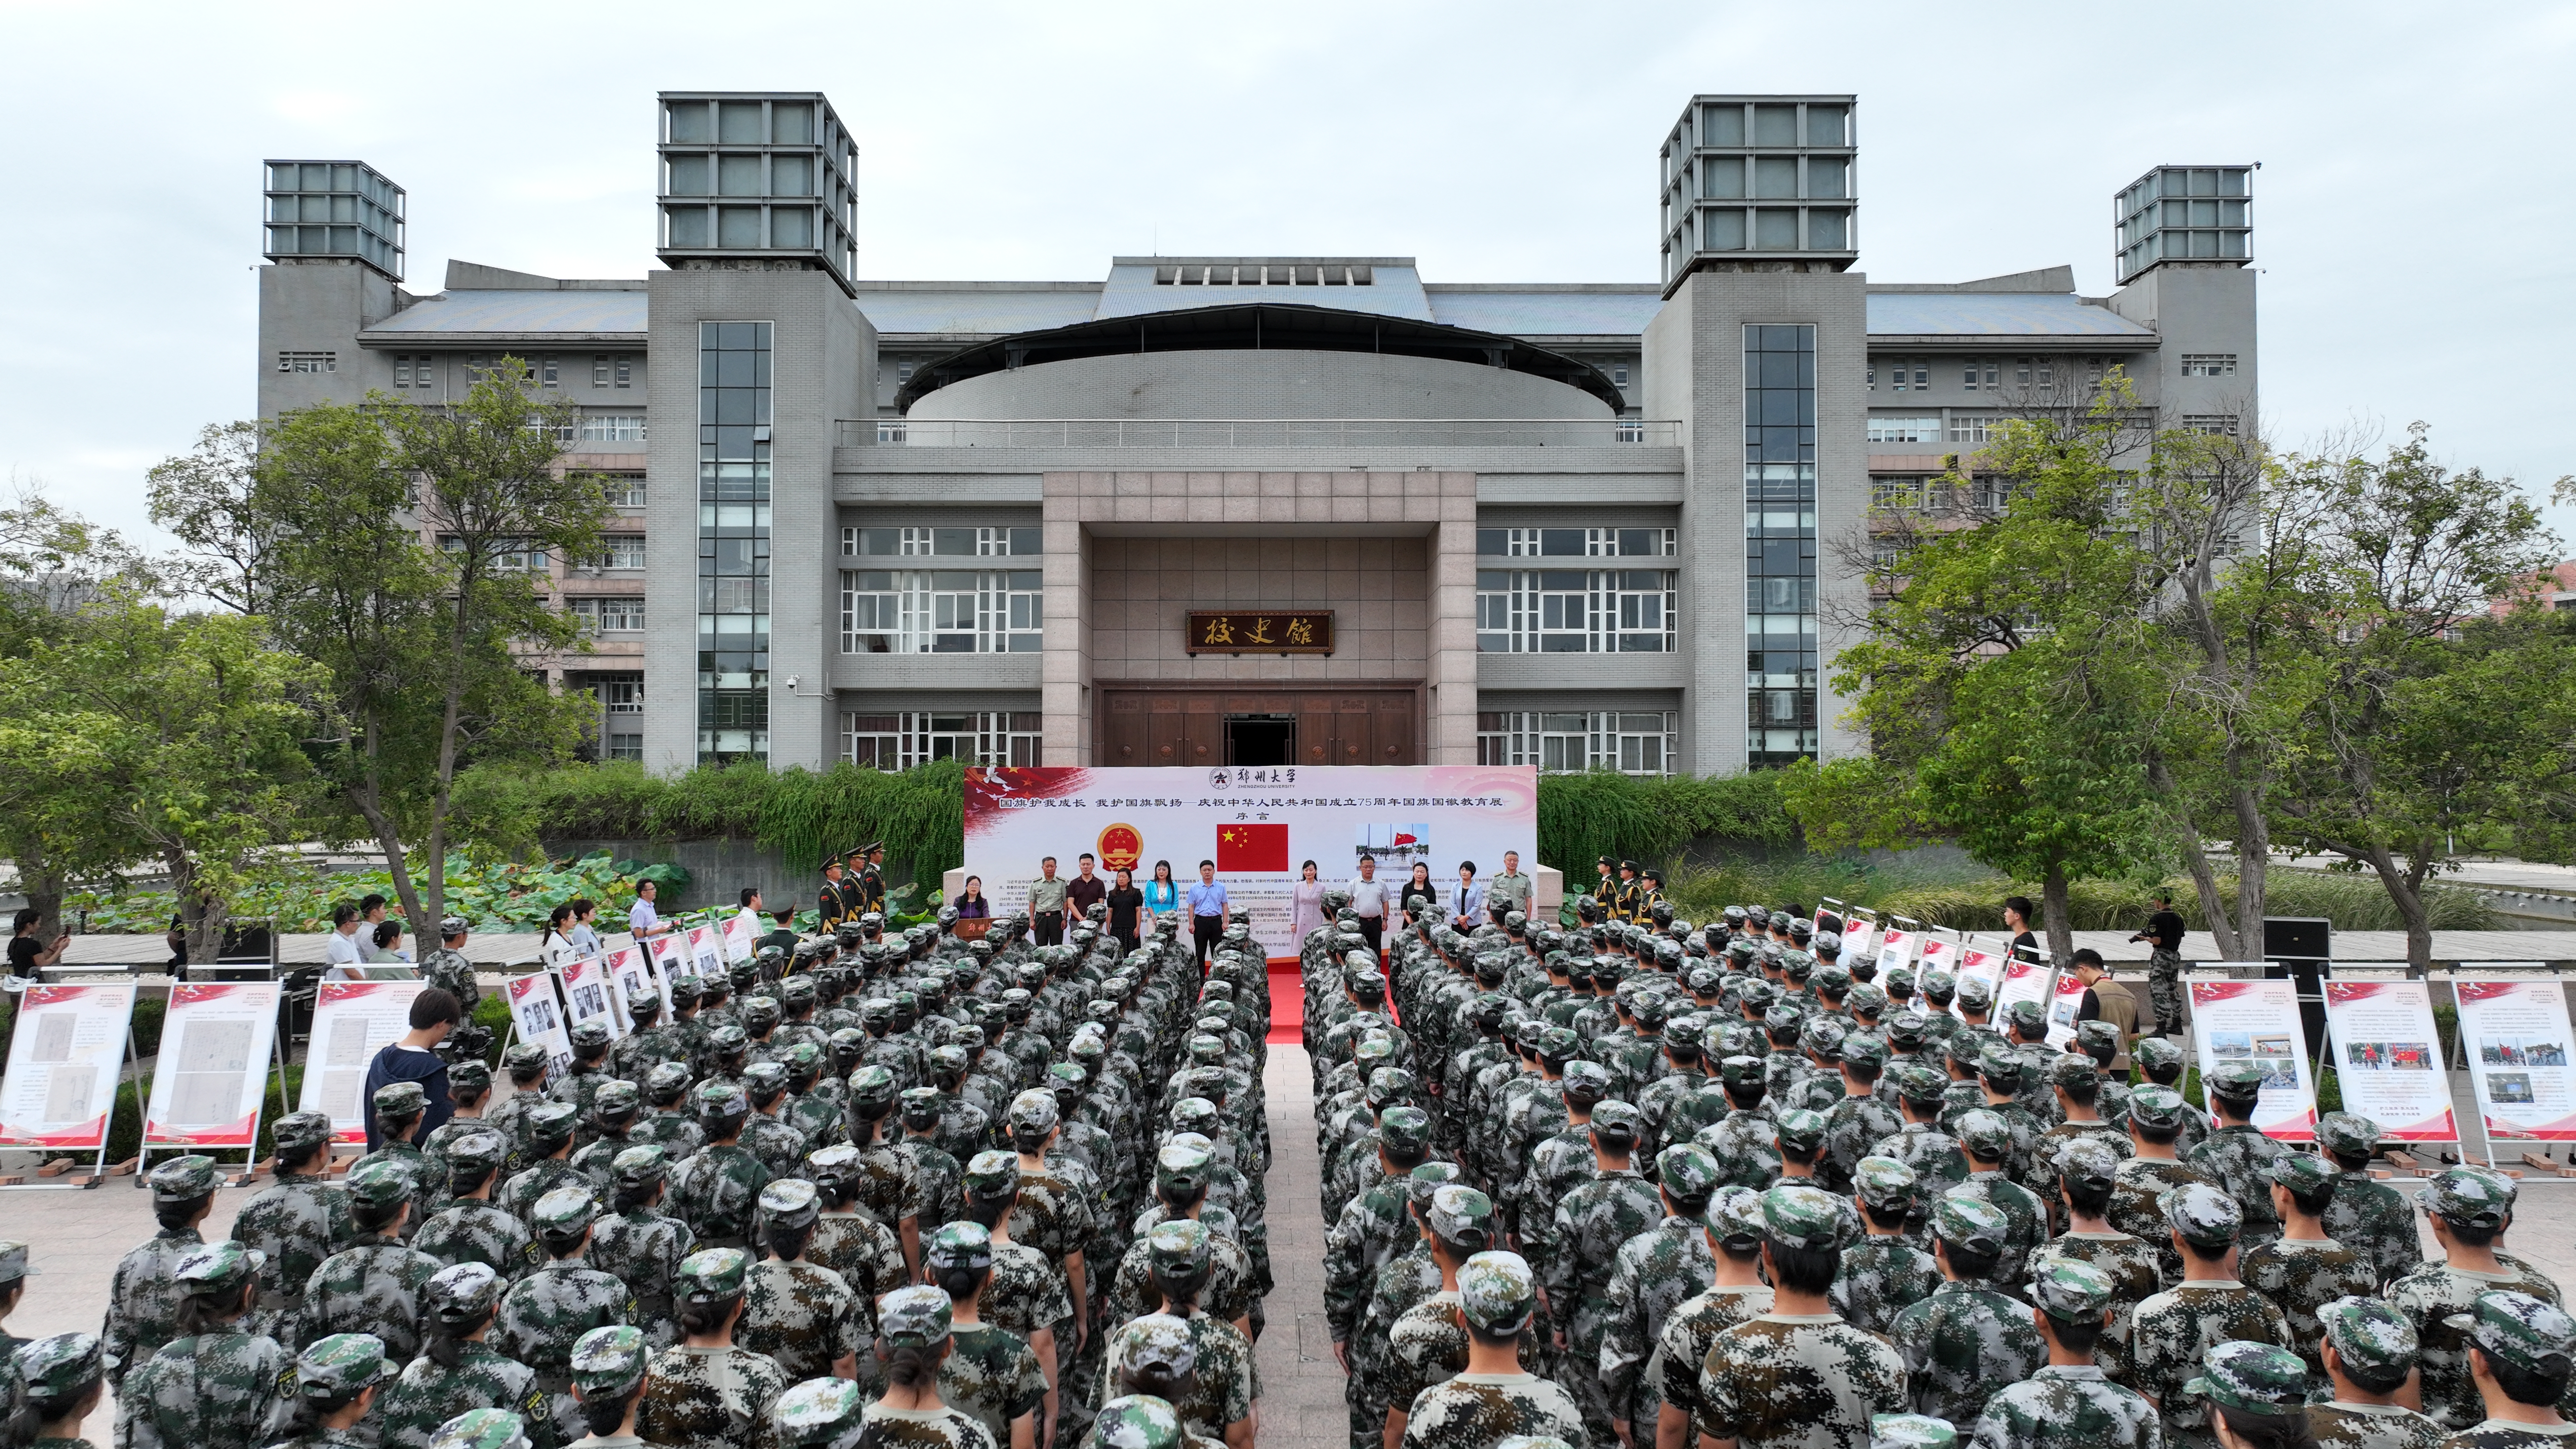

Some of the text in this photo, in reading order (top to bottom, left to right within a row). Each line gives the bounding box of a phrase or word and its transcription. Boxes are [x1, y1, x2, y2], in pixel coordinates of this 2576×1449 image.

[1238, 768, 1296, 784] 郑州大学
[1000, 798, 1086, 807] 国旗护我成长
[1235, 812, 1269, 820] 序言
